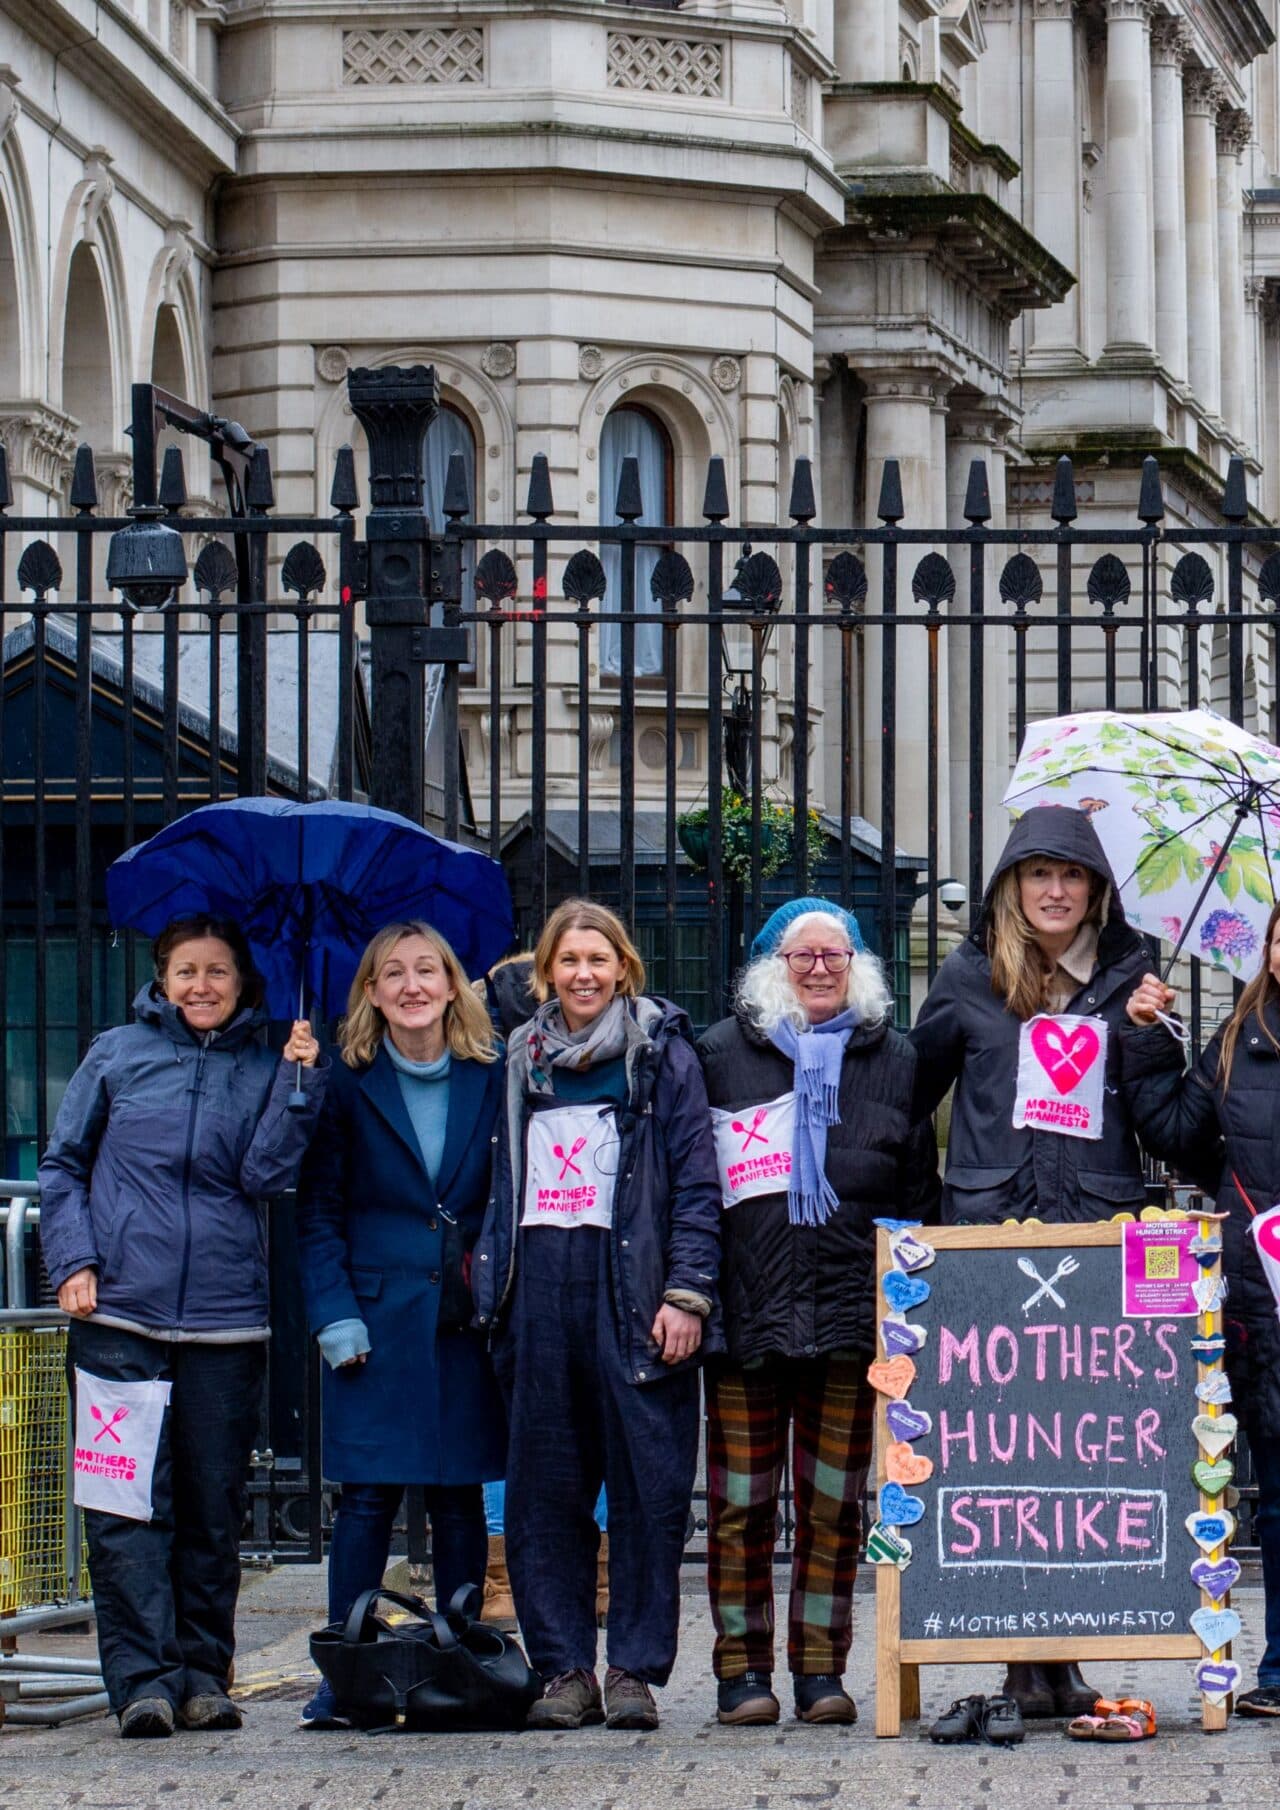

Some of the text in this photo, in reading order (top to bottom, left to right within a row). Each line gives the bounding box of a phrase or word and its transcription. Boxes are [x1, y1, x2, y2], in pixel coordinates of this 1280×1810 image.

[1023, 1111, 1089, 1129] MANIFESTO
[1025, 1098, 1090, 1119] MOTHERS
[727, 1151, 792, 1179] MOTHERS
[730, 1164, 792, 1191] MANIFESTO
[537, 1185, 597, 1200] MOTHERS
[938, 1321, 1179, 1385] MOTHER'S
[939, 1408, 1166, 1469] HUNGER
[74, 1461, 135, 1481] MANIFESTO
[75, 1447, 137, 1470] MOTHERS
[950, 1496, 1153, 1554] STRIKE
[923, 1611, 1175, 1637] #MOTHERSMANIFESTO
